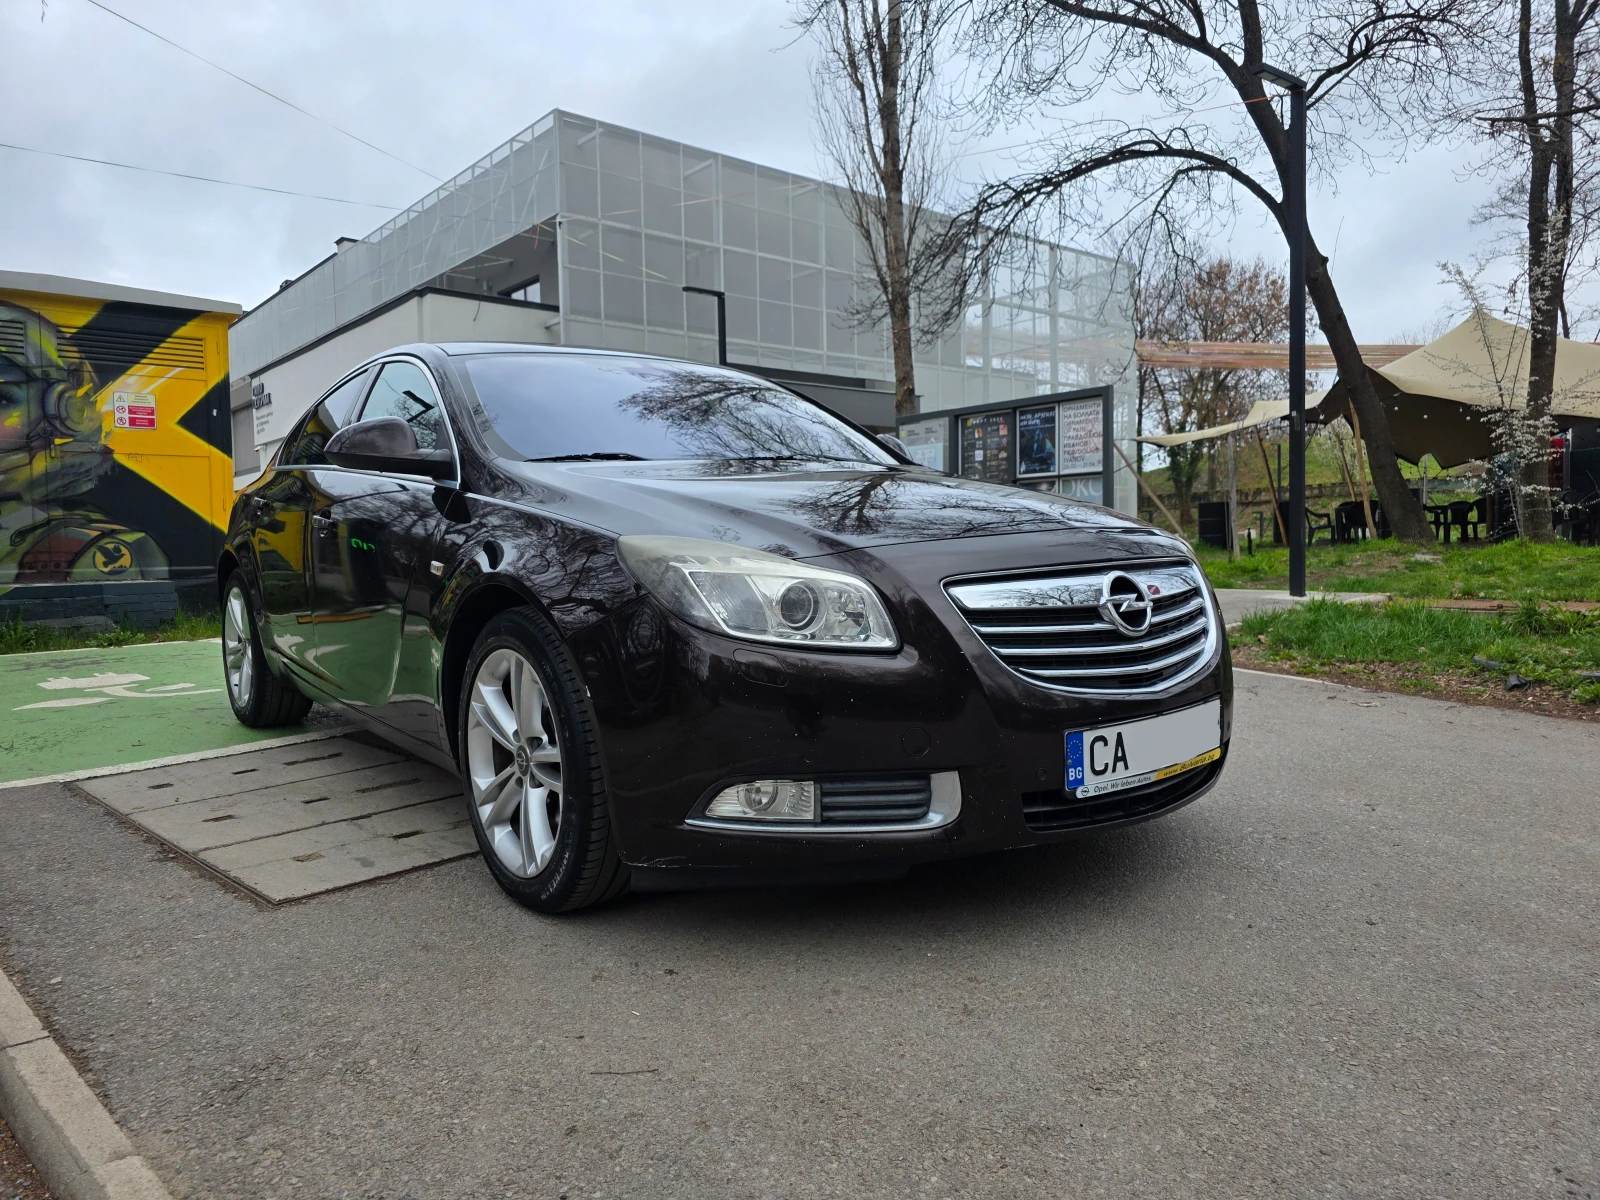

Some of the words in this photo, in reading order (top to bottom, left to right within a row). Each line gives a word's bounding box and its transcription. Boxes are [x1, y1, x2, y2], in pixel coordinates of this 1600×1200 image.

[1063, 402, 1101, 412] ОРНАМЕНТИ
[1073, 409, 1100, 418] БОЛКАТА
[1063, 440, 1088, 449] ИВАНОВ
[1063, 455, 1085, 464] IVANOV
[1090, 731, 1129, 776] CA
[1068, 766, 1082, 781] BG
[1110, 781, 1120, 790] Wir
